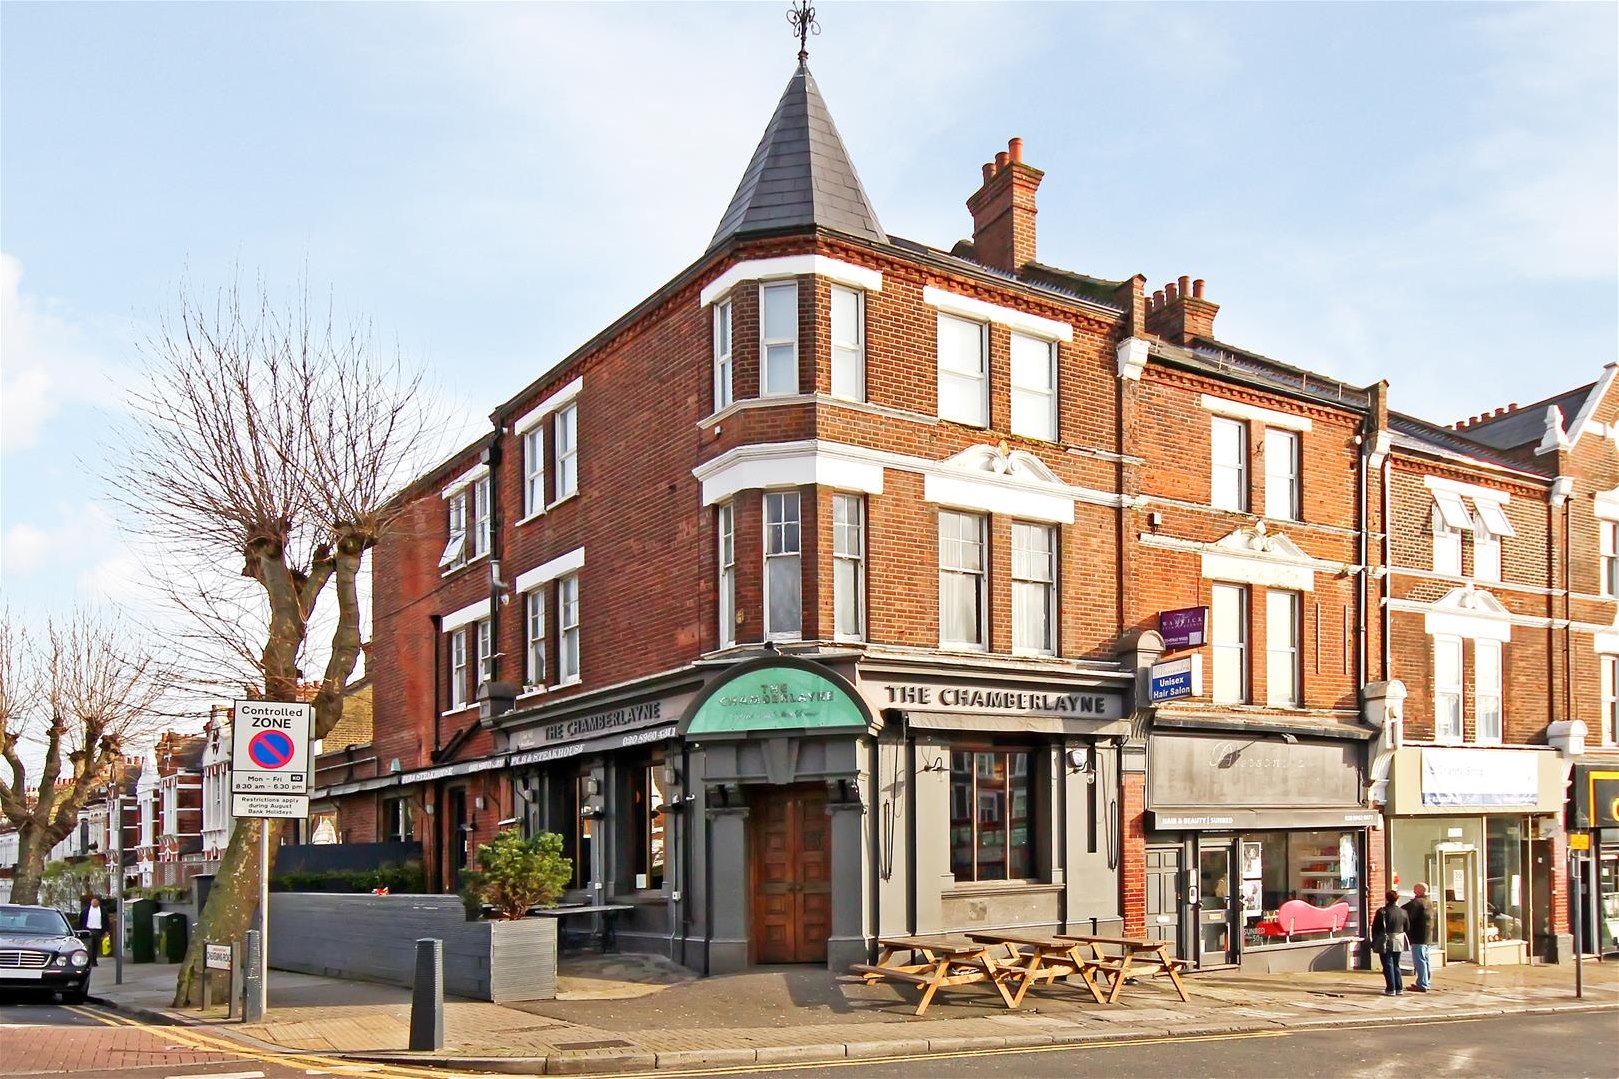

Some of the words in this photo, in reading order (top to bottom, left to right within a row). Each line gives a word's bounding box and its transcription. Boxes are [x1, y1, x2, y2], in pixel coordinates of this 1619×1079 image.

[1159, 677, 1184, 687] Unisex
[760, 683, 788, 694] THE
[1153, 690, 1169, 699] Hair
[1170, 686, 1190, 696] Salon
[719, 691, 834, 706] CHAMBERLAYNE
[885, 685, 932, 705] THE
[938, 688, 1105, 713] CHAMBERLAYNE
[241, 706, 303, 717] Controlled
[252, 718, 291, 728] ZONE
[545, 724, 564, 740] THE
[567, 703, 661, 736] CHAMBERLAYNE
[1162, 817, 1177, 825] HAIR
[1183, 816, 1207, 824] BEAUTY
[1210, 816, 1234, 824] SUNBED
